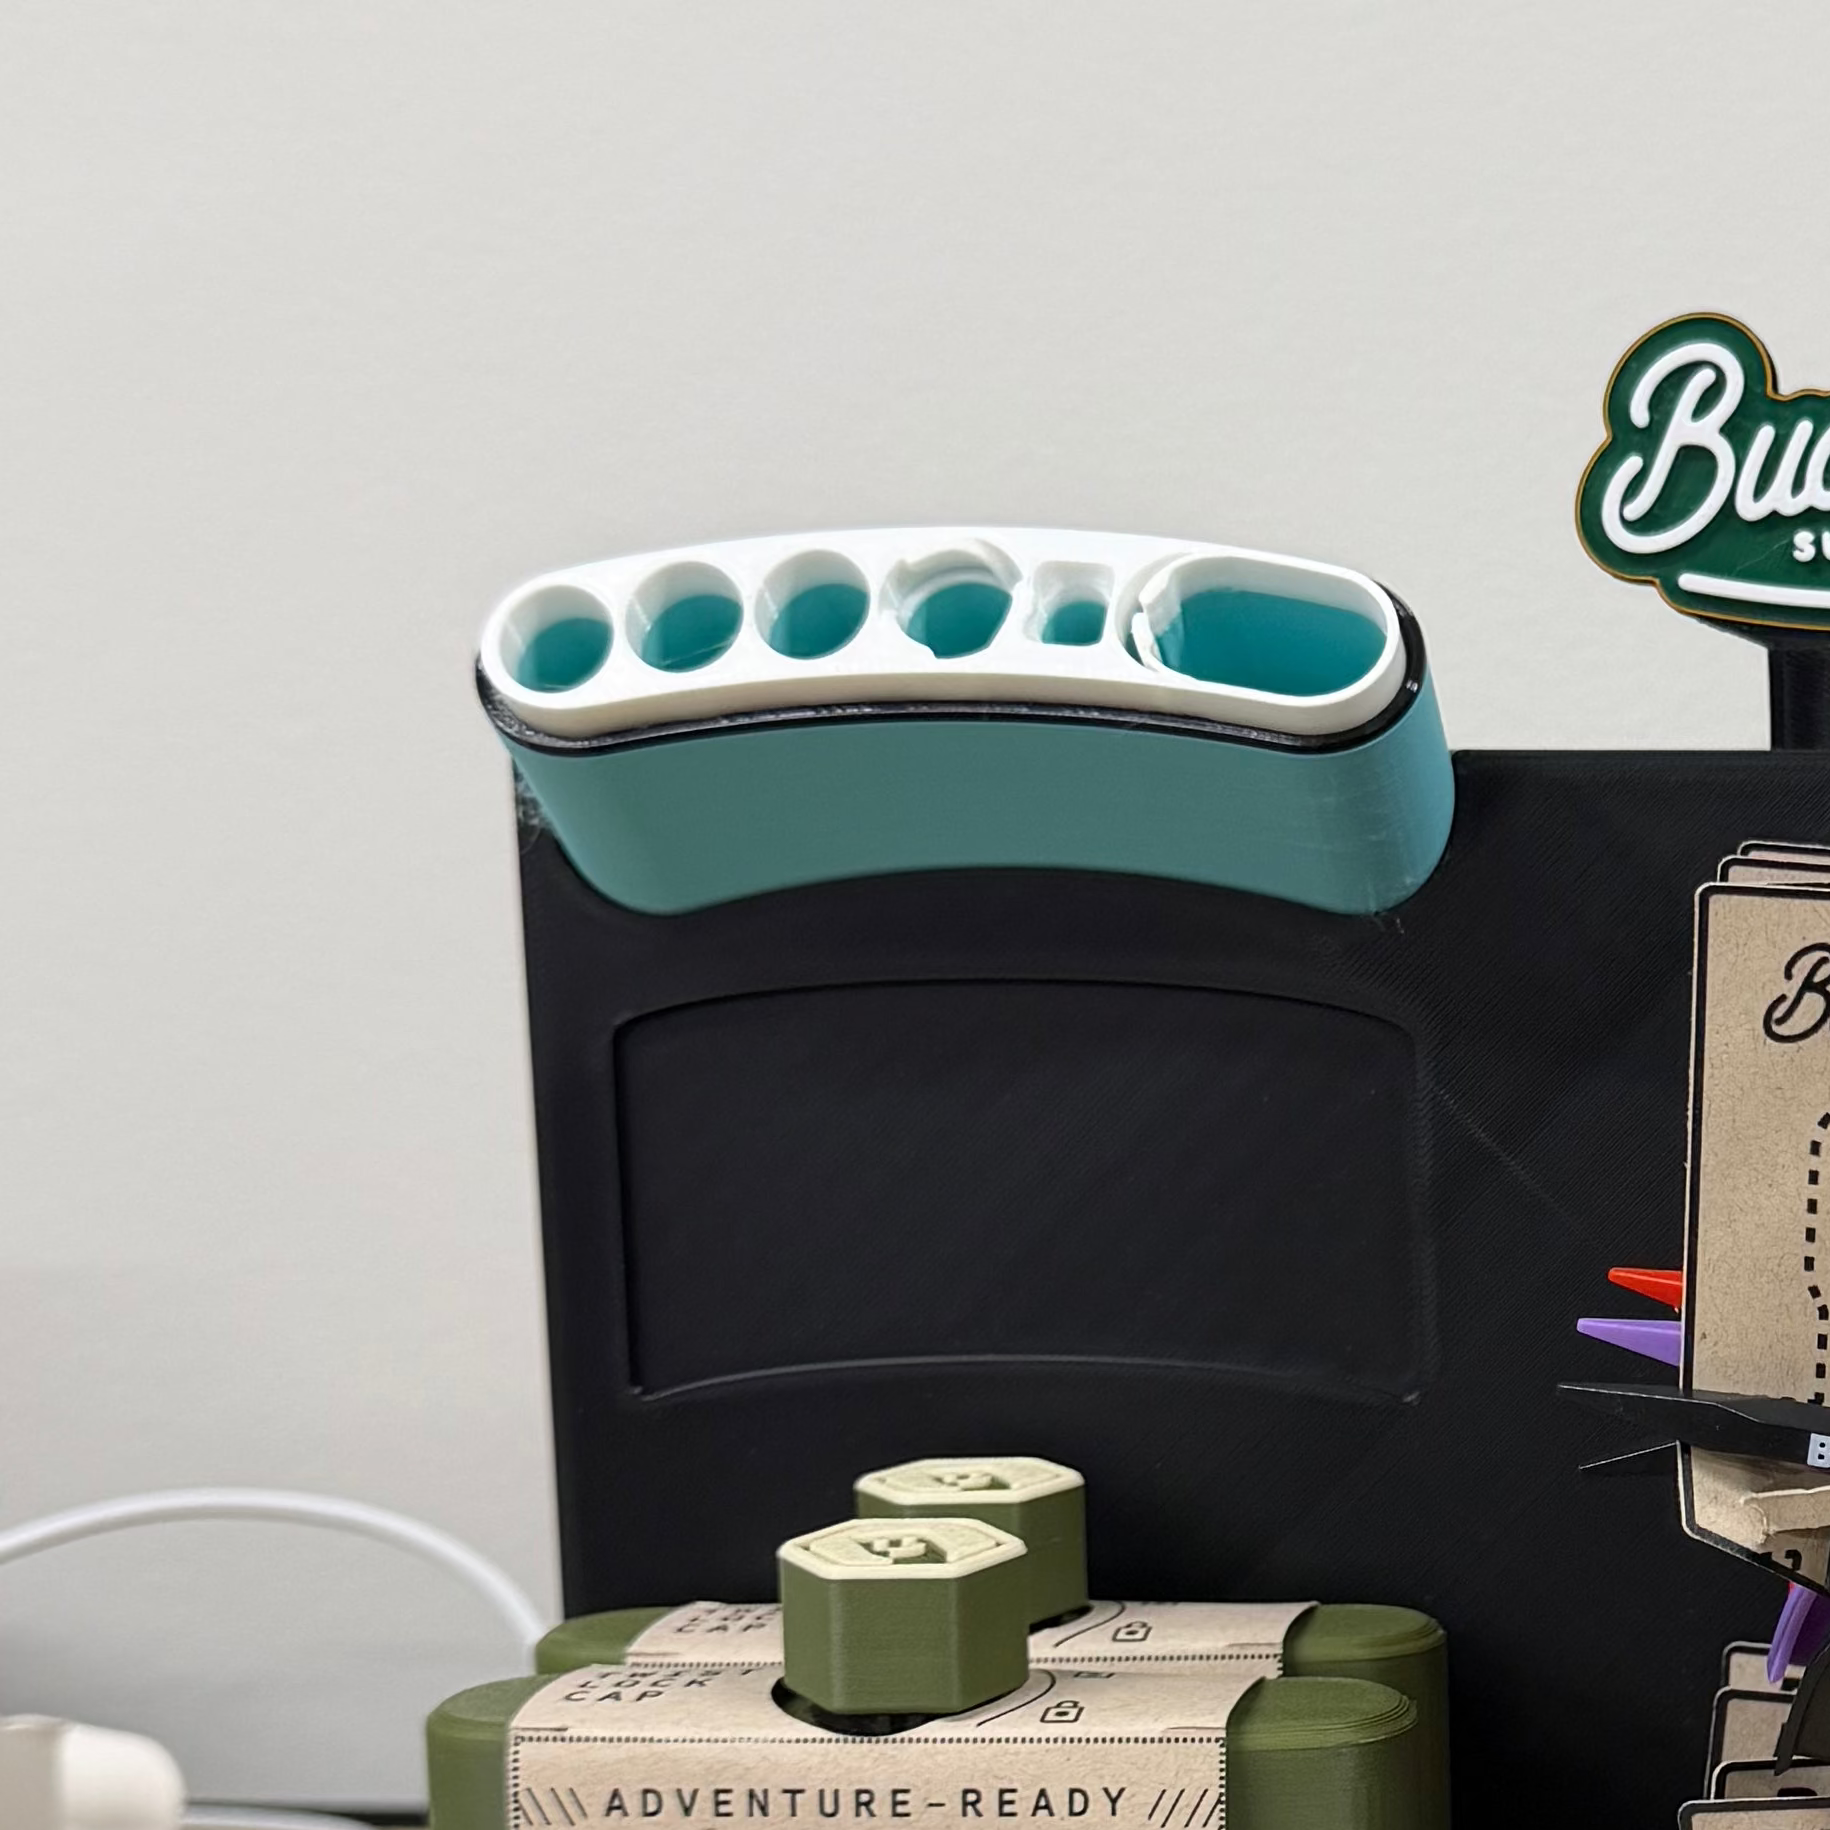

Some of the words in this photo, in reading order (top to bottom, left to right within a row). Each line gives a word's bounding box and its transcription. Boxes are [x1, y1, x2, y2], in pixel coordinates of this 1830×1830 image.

[578, 1678, 714, 1689] LOCK
[563, 1690, 664, 1702] CAP
[604, 1786, 1128, 1821] ADVENTURE-READY
